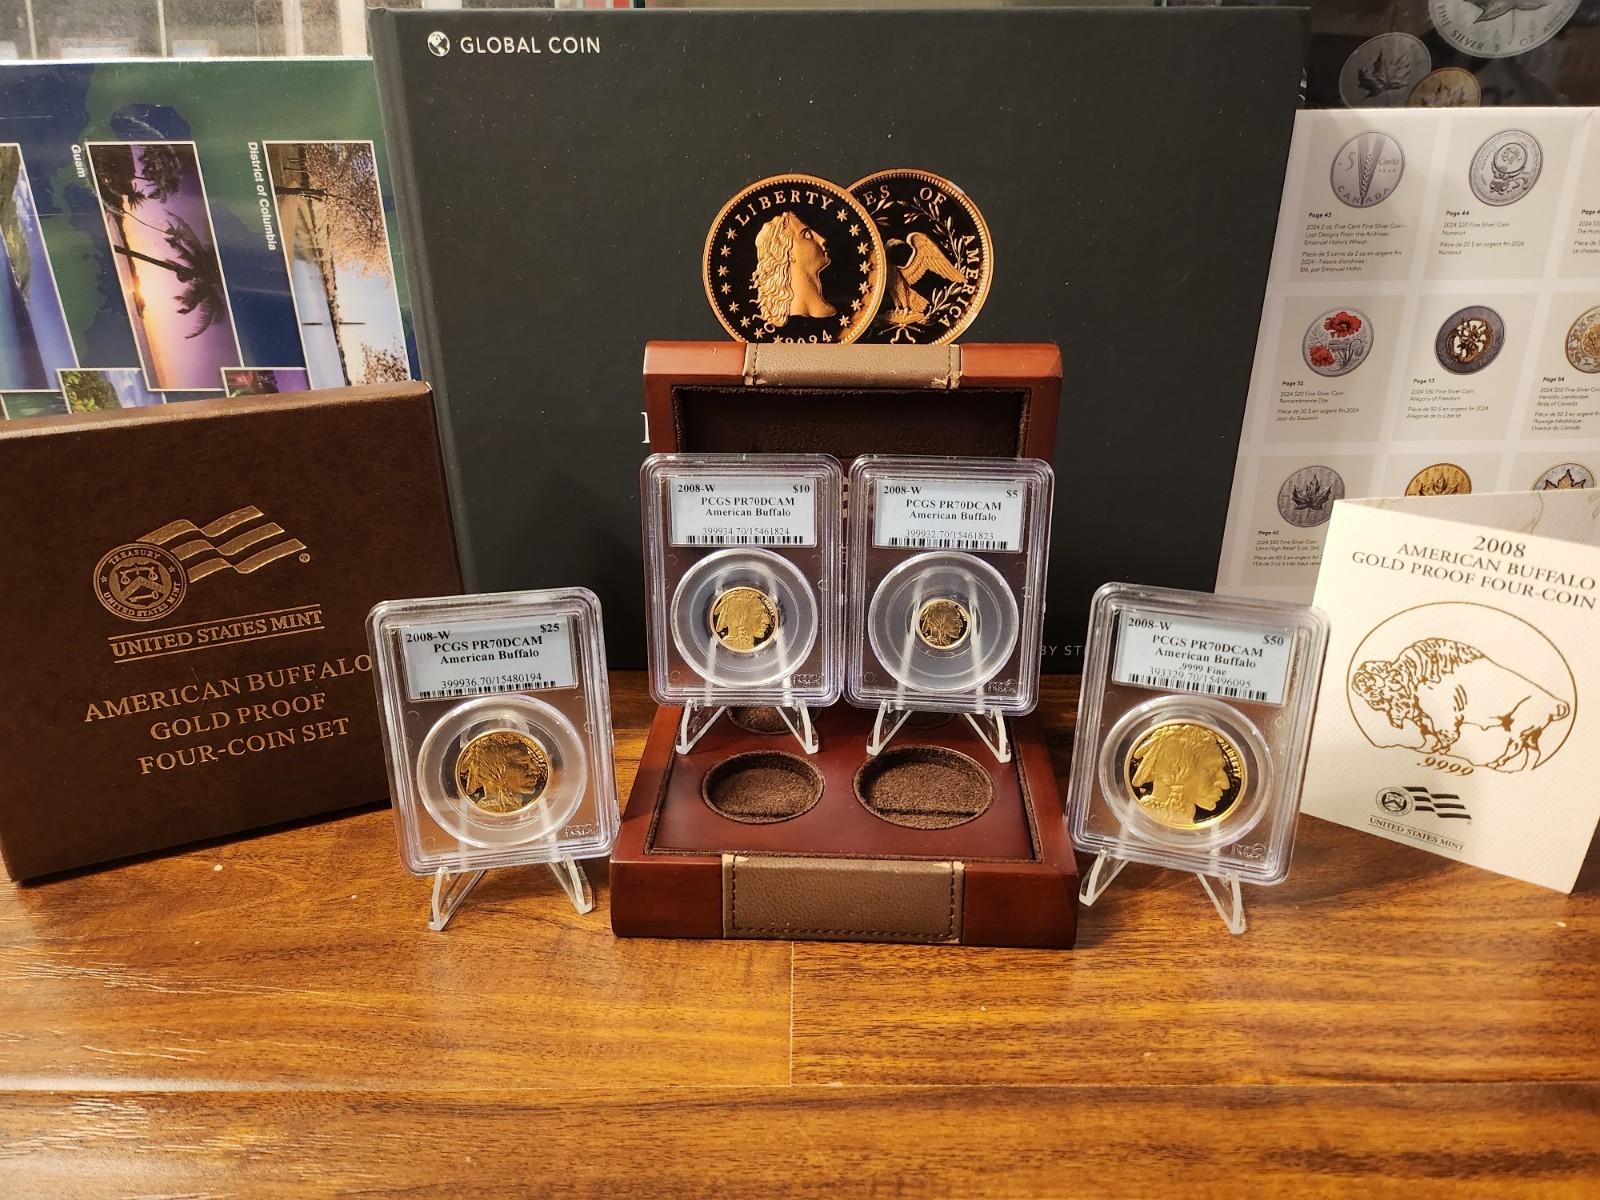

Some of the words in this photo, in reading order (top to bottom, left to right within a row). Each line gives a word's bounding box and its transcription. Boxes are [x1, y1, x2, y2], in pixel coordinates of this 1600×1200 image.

[460, 36, 542, 54] GLOBAL
[548, 36, 601, 54] COIN
[1450, 30, 1484, 51] SILVER
[71, 144, 86, 178] Guam
[248, 141, 265, 183] District
[256, 184, 268, 197] of
[1338, 185, 1391, 203] CANADA
[735, 189, 834, 226] LIBERTY
[1308, 212, 1323, 220] Page
[1446, 210, 1461, 218] Page
[259, 198, 277, 251] Columbia
[919, 187, 947, 206] OF
[938, 234, 979, 327] AMERICA
[1282, 380, 1297, 388] Page
[678, 483, 716, 494] 2008-W
[792, 484, 811, 494] $10
[883, 485, 923, 495] 2008-W
[1005, 489, 1019, 499] $5
[701, 496, 732, 507] PCGS
[734, 496, 796, 507] PR70DCAM
[906, 499, 937, 510] PCGS
[939, 499, 1002, 511] PR70DCAM
[706, 508, 752, 517] American
[755, 507, 791, 517] Buffalo
[909, 510, 958, 521] American
[960, 511, 997, 522] Buffalo
[1473, 535, 1527, 559] 2008
[108, 548, 162, 567] TREASURY
[1396, 543, 1502, 573] AMERICAN
[1507, 562, 1597, 592] BUFFALO
[1352, 551, 1406, 572] GOLD
[1410, 562, 1477, 586] PROOF
[1480, 576, 1597, 611] FOUR-COIN
[103, 591, 137, 617] UNITED
[136, 603, 167, 618] STATES
[165, 581, 182, 607] MINT
[110, 632, 194, 659] UNITED
[197, 618, 268, 645] STATES
[270, 610, 323, 632] MINT
[406, 629, 451, 643] 2008-W
[539, 623, 560, 634] $25
[1128, 617, 1173, 632] 2008-W
[1262, 634, 1284, 647] $50
[433, 641, 469, 654] PCGS
[471, 636, 543, 651] PR70DCAM
[1041, 644, 1058, 656] BY
[1152, 634, 1188, 649] PCGS
[1190, 638, 1264, 659] PR70DCAM
[439, 652, 495, 665] American
[498, 648, 540, 660] Buffalo
[1154, 647, 1210, 663] American
[1213, 654, 1257, 670] Buffalo
[1179, 662, 1204, 673] .9999
[1206, 665, 1228, 676] Fine
[84, 676, 242, 723] AMERICAN
[245, 653, 374, 693] BUFFALO
[441, 672, 543, 690] 399936.70/15480194
[150, 711, 231, 742] GOLD
[235, 692, 327, 726] PROOF
[136, 727, 297, 776] FOUR-COIN
[300, 717, 351, 744] SET
[1220, 742, 1242, 779] LIBERTY
[1370, 817, 1405, 833] UNITED
[1406, 828, 1438, 844] STATES
[1439, 838, 1465, 851] MINT
